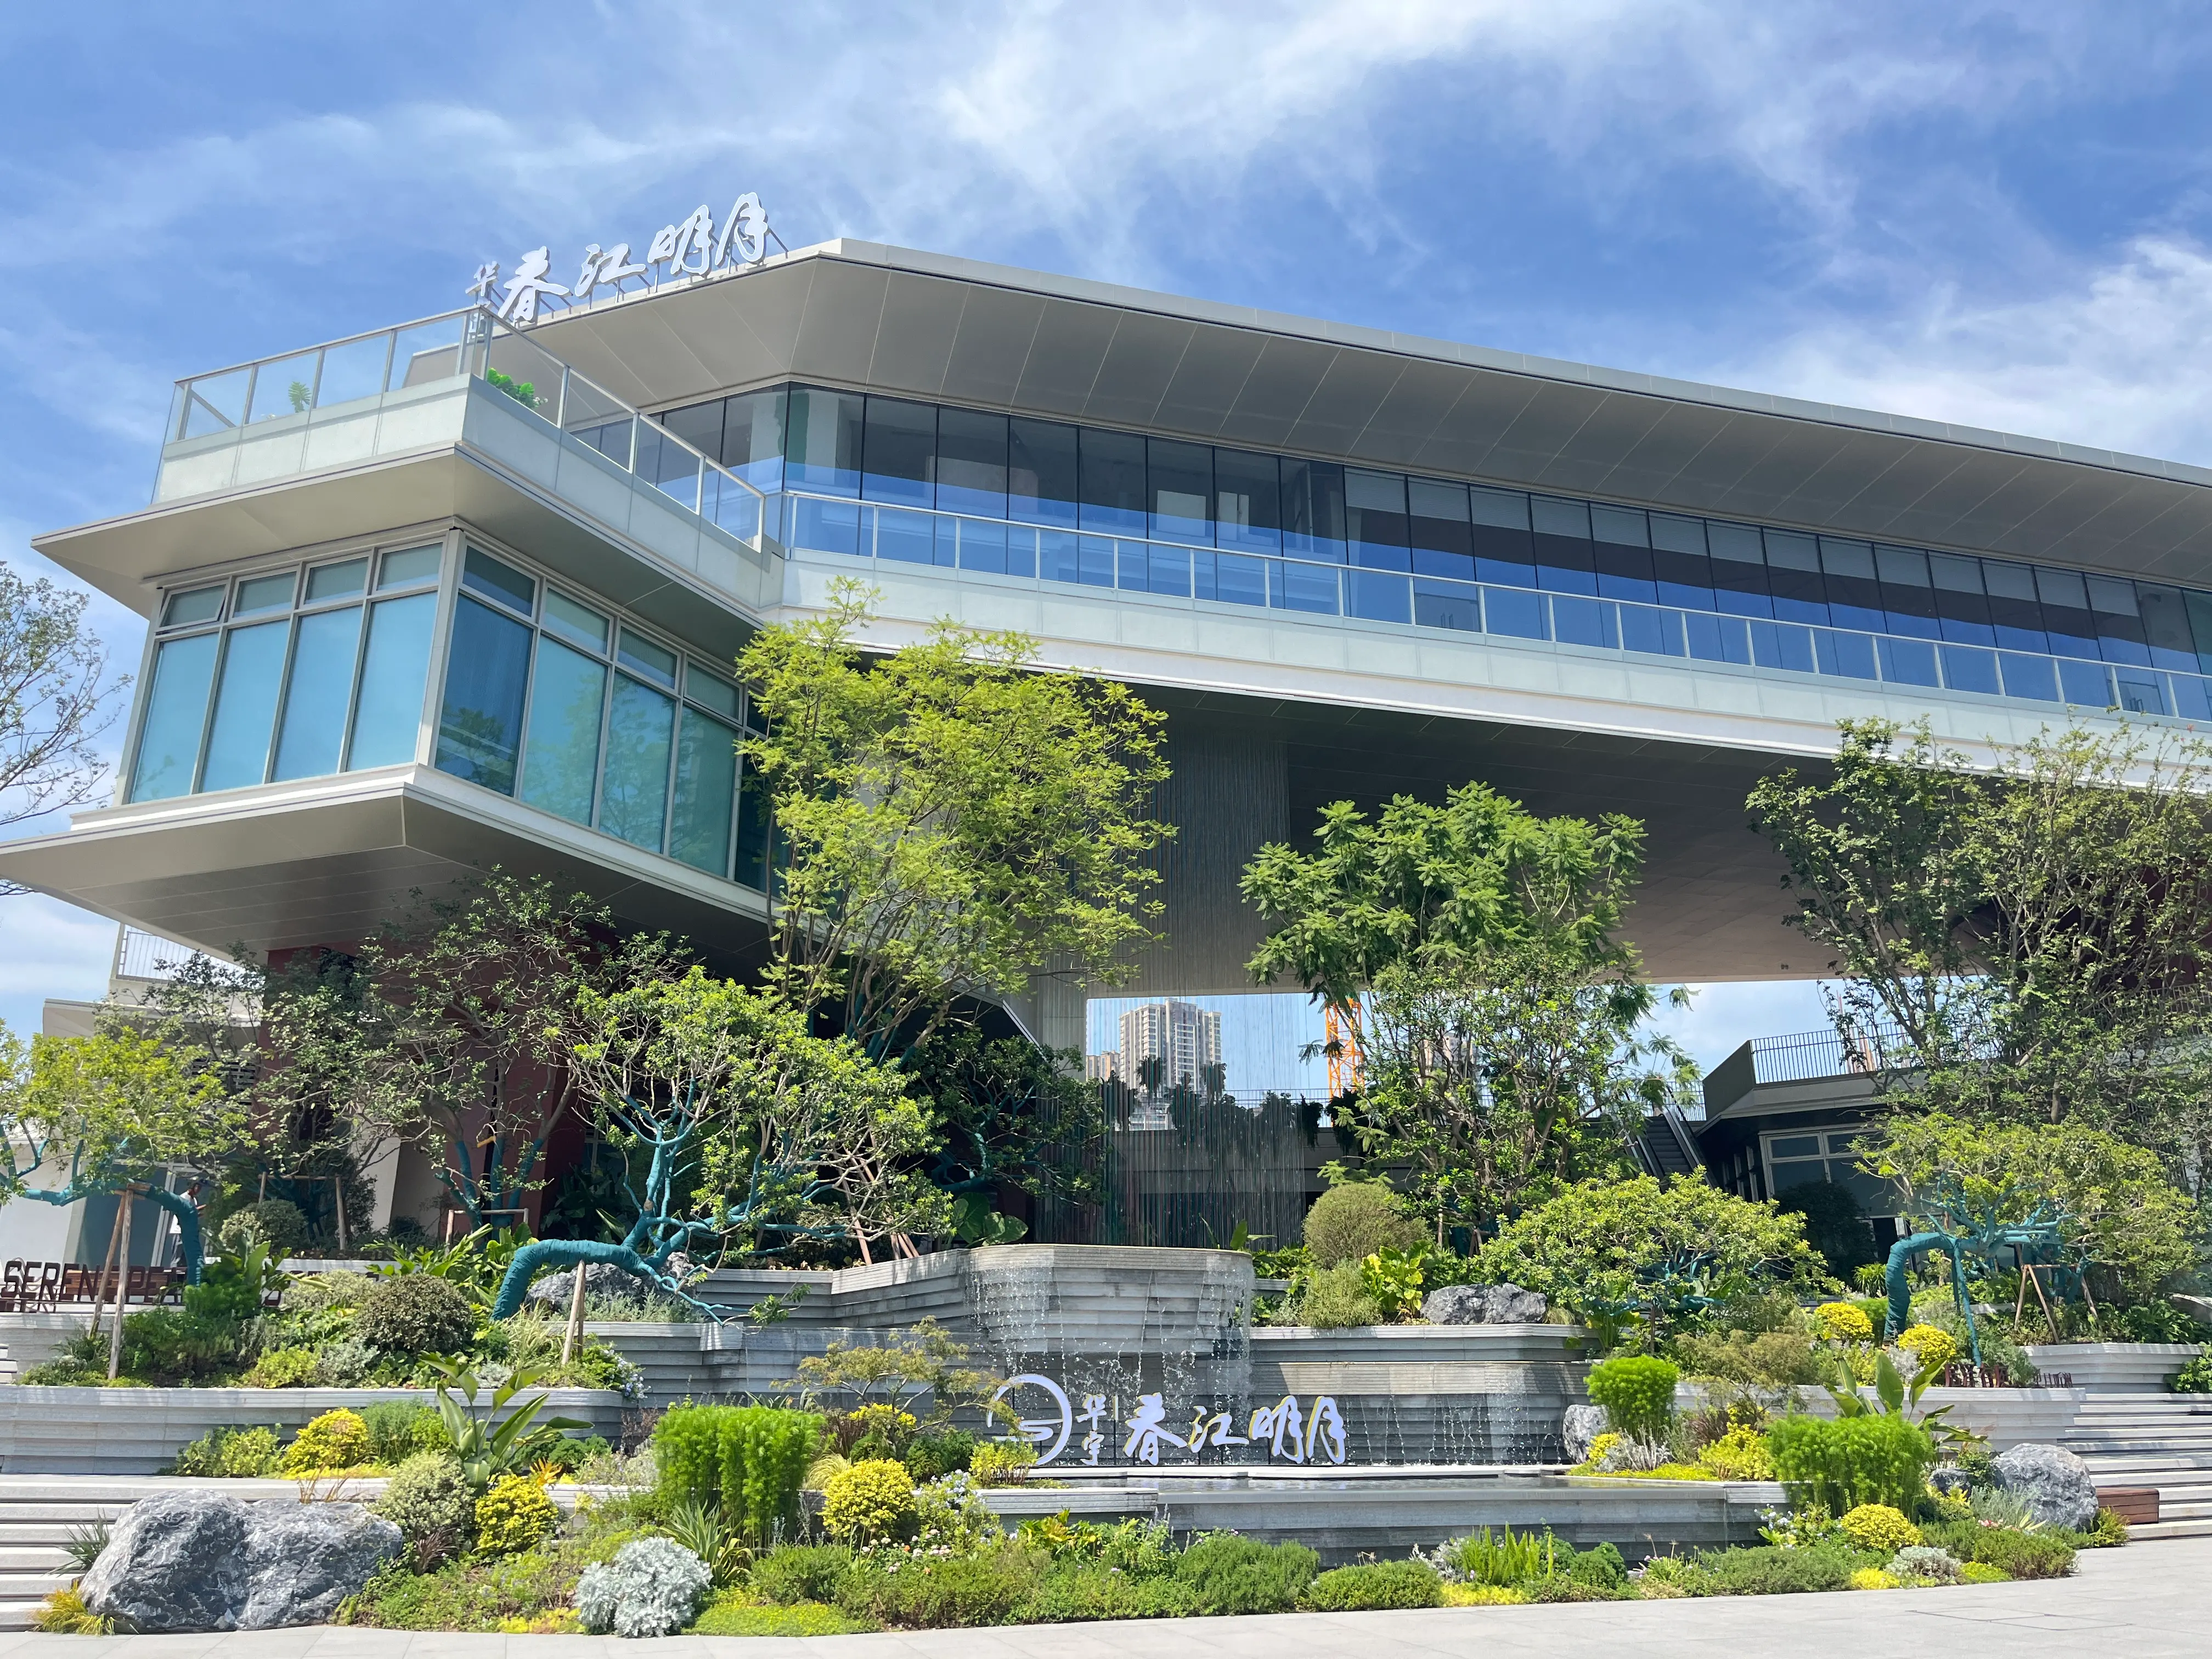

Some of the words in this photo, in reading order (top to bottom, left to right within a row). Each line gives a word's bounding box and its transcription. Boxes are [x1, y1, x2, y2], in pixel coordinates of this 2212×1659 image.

[498, 191, 769, 323] 春江明月
[1123, 1392, 1347, 1466] 春江明月
